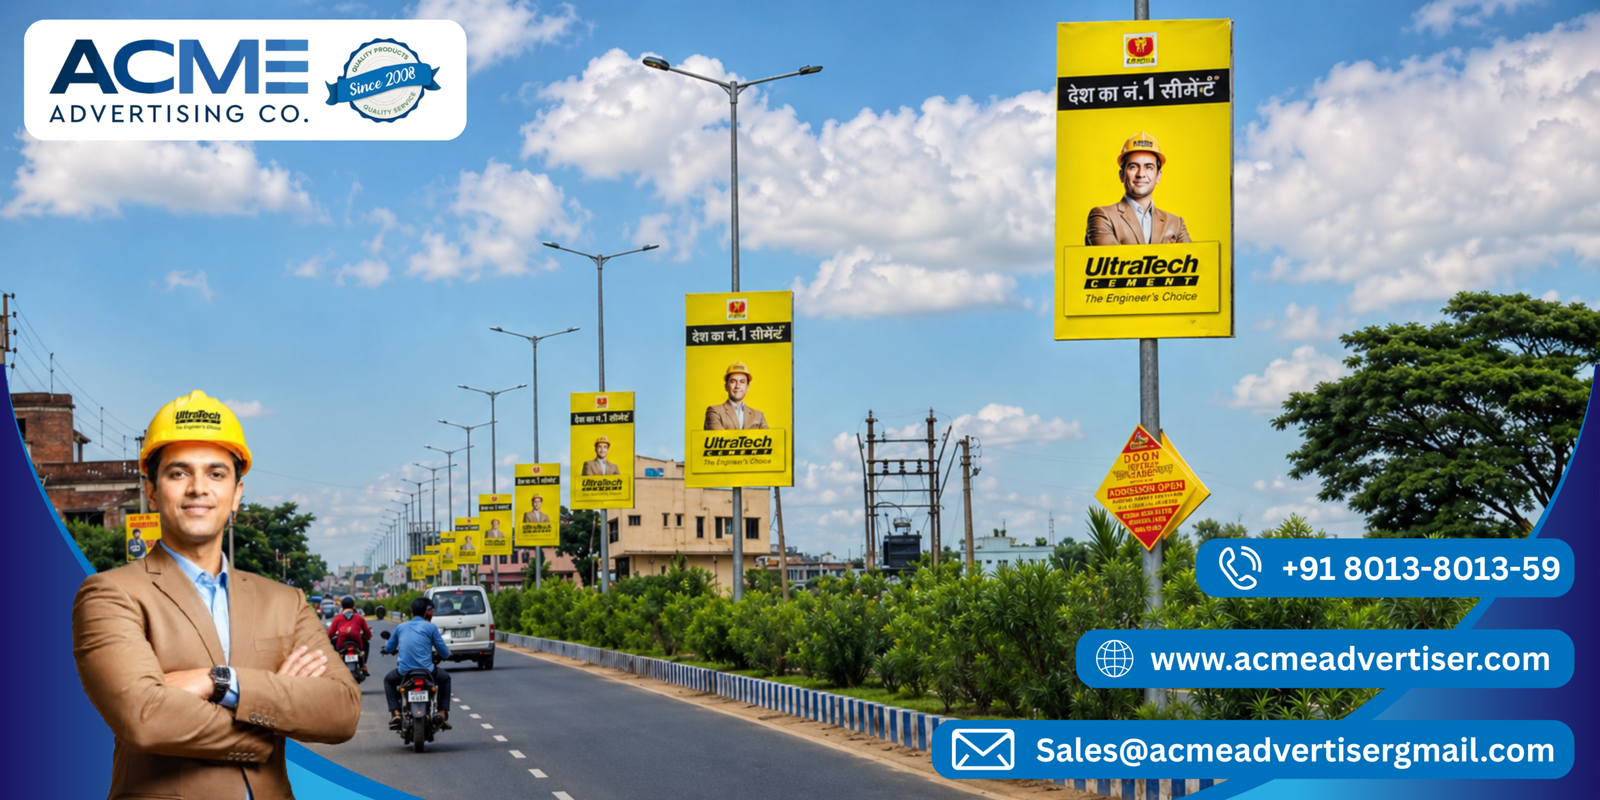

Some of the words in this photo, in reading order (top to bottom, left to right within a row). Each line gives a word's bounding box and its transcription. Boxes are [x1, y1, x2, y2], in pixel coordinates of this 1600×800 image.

[1067, 84, 1095, 105] देश
[1098, 86, 1119, 102] का
[1085, 254, 1199, 277] UltraTech
[1090, 277, 1194, 288] CEMENT
[1085, 294, 1104, 303] The
[1106, 292, 1159, 305] Engineer's
[1162, 292, 1198, 302] Choice
[175, 410, 221, 420] UltraTech
[704, 435, 772, 449] UltraTech
[1124, 451, 1159, 464] DOON
